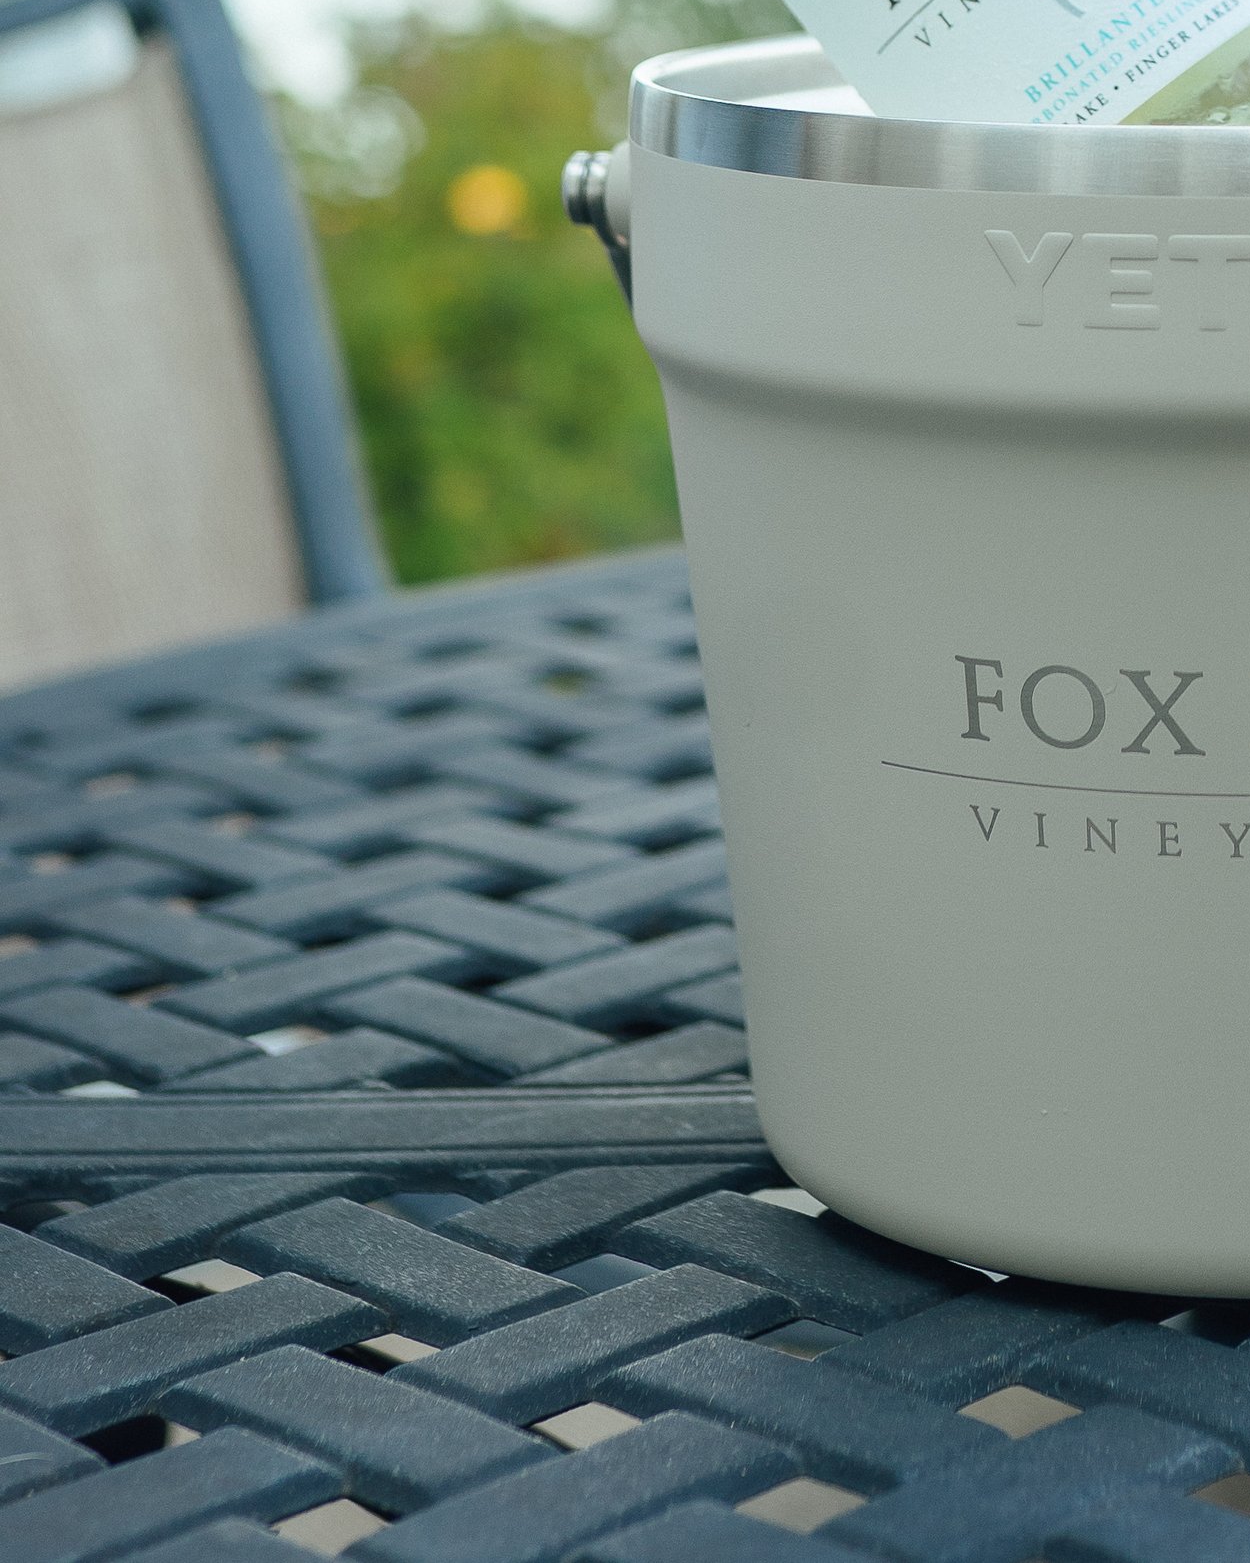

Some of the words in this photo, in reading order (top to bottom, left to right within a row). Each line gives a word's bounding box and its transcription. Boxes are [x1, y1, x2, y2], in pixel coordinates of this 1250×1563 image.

[1063, 93, 1109, 124] AKE
[1125, 30, 1191, 82] FINGER
[955, 654, 1206, 757] FOX
